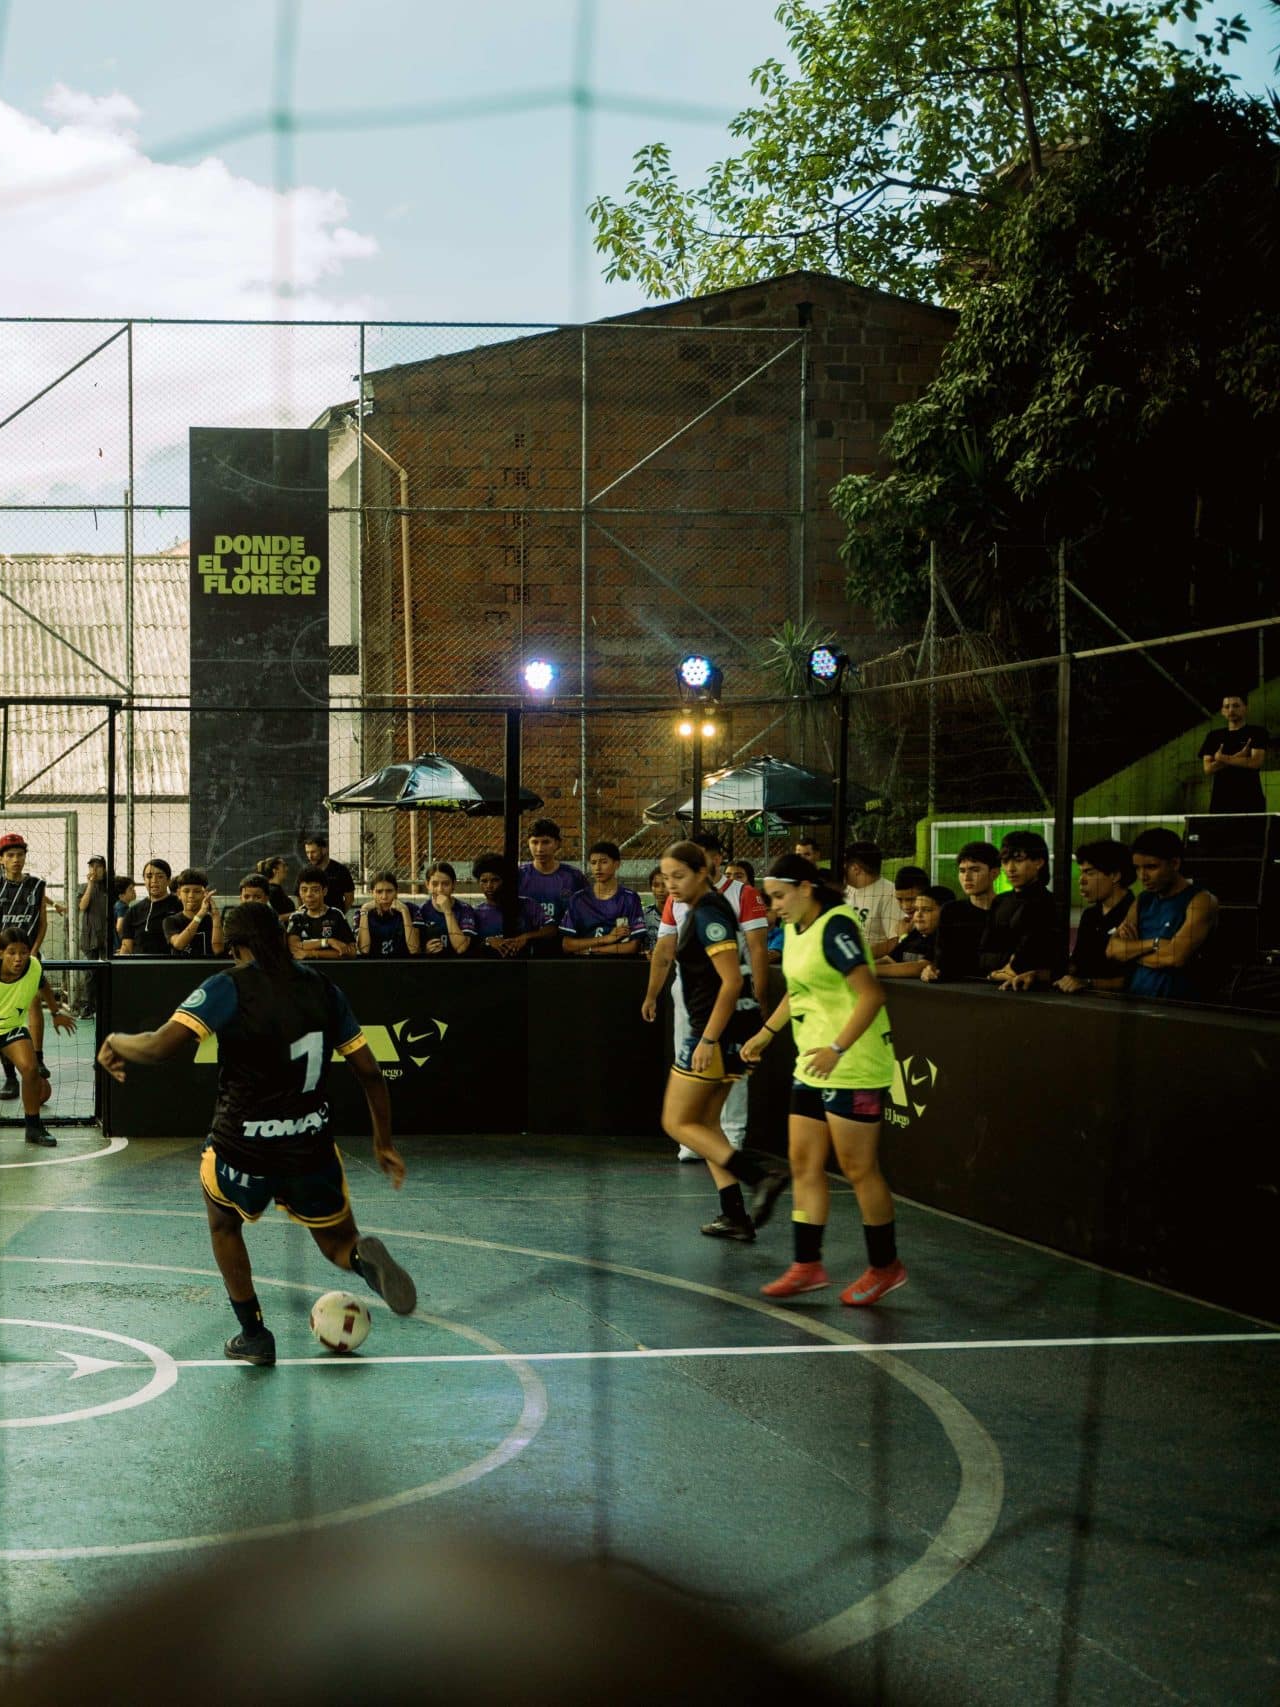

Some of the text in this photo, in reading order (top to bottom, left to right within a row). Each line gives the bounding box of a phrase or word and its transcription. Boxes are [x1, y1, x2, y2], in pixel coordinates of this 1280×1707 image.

[214, 535, 305, 555] DONDE
[197, 555, 321, 575] EL JUEGO
[203, 574, 317, 595] FLORECE
[242, 1112, 322, 1137] TOMA
[884, 1107, 909, 1128] El Juego
